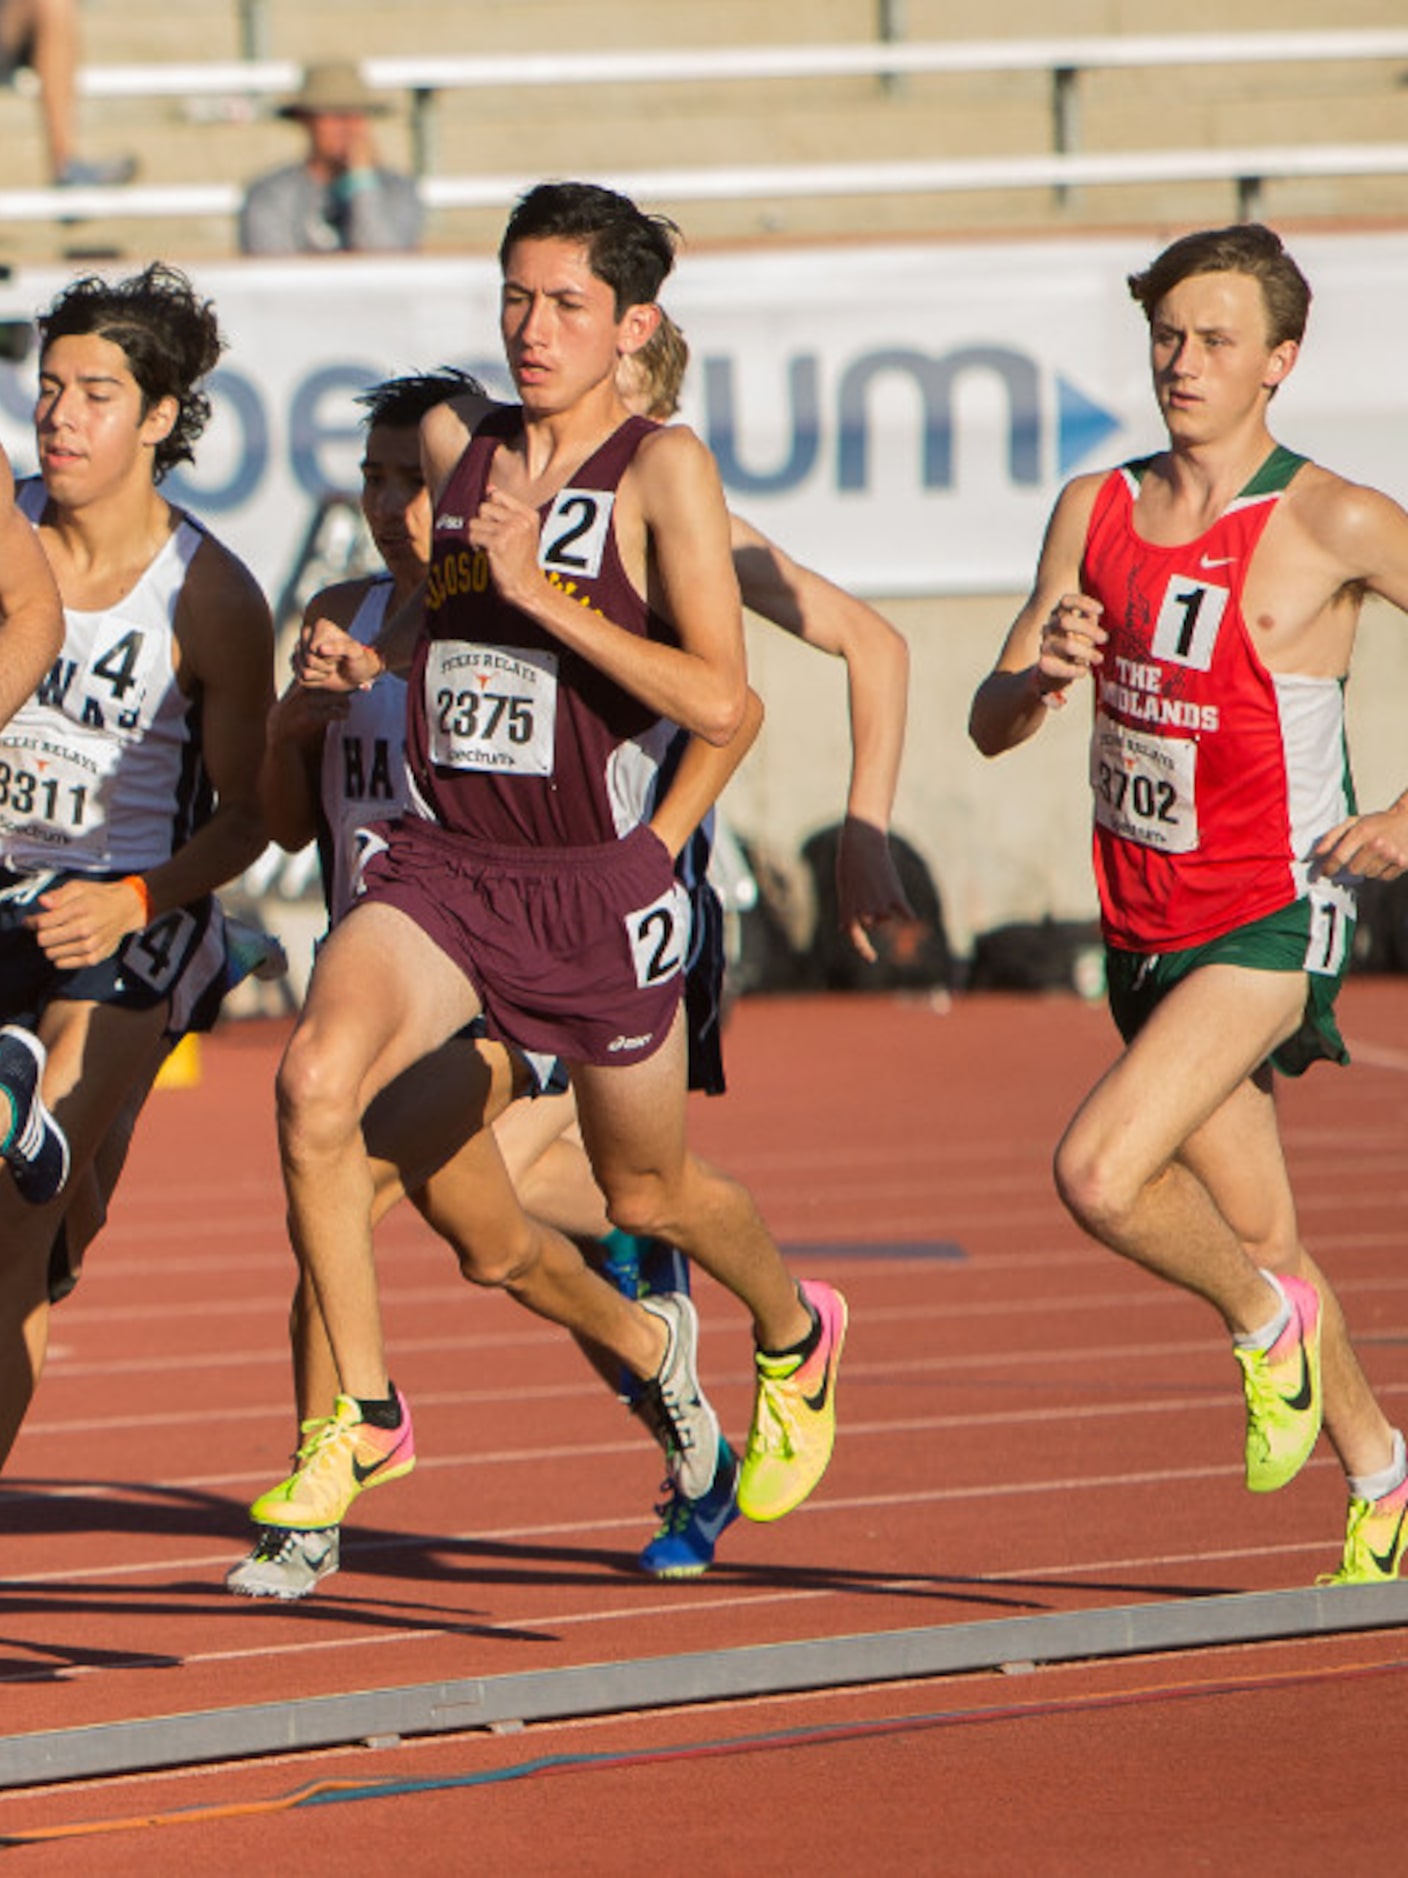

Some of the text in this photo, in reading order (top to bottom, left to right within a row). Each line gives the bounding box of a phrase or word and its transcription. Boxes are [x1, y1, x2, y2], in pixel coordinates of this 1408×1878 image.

[545, 496, 598, 568] 2
[1174, 586, 1208, 657] 1
[91, 629, 144, 701] 4
[441, 653, 537, 683] TEXAS RELAYS
[1115, 656, 1162, 694] THE
[437, 687, 534, 745] 2375
[41, 741, 98, 775] RELAYS
[1098, 760, 1179, 824] 3702
[138, 912, 185, 977] 4
[638, 907, 680, 982] 2
[1321, 901, 1337, 967] 1
